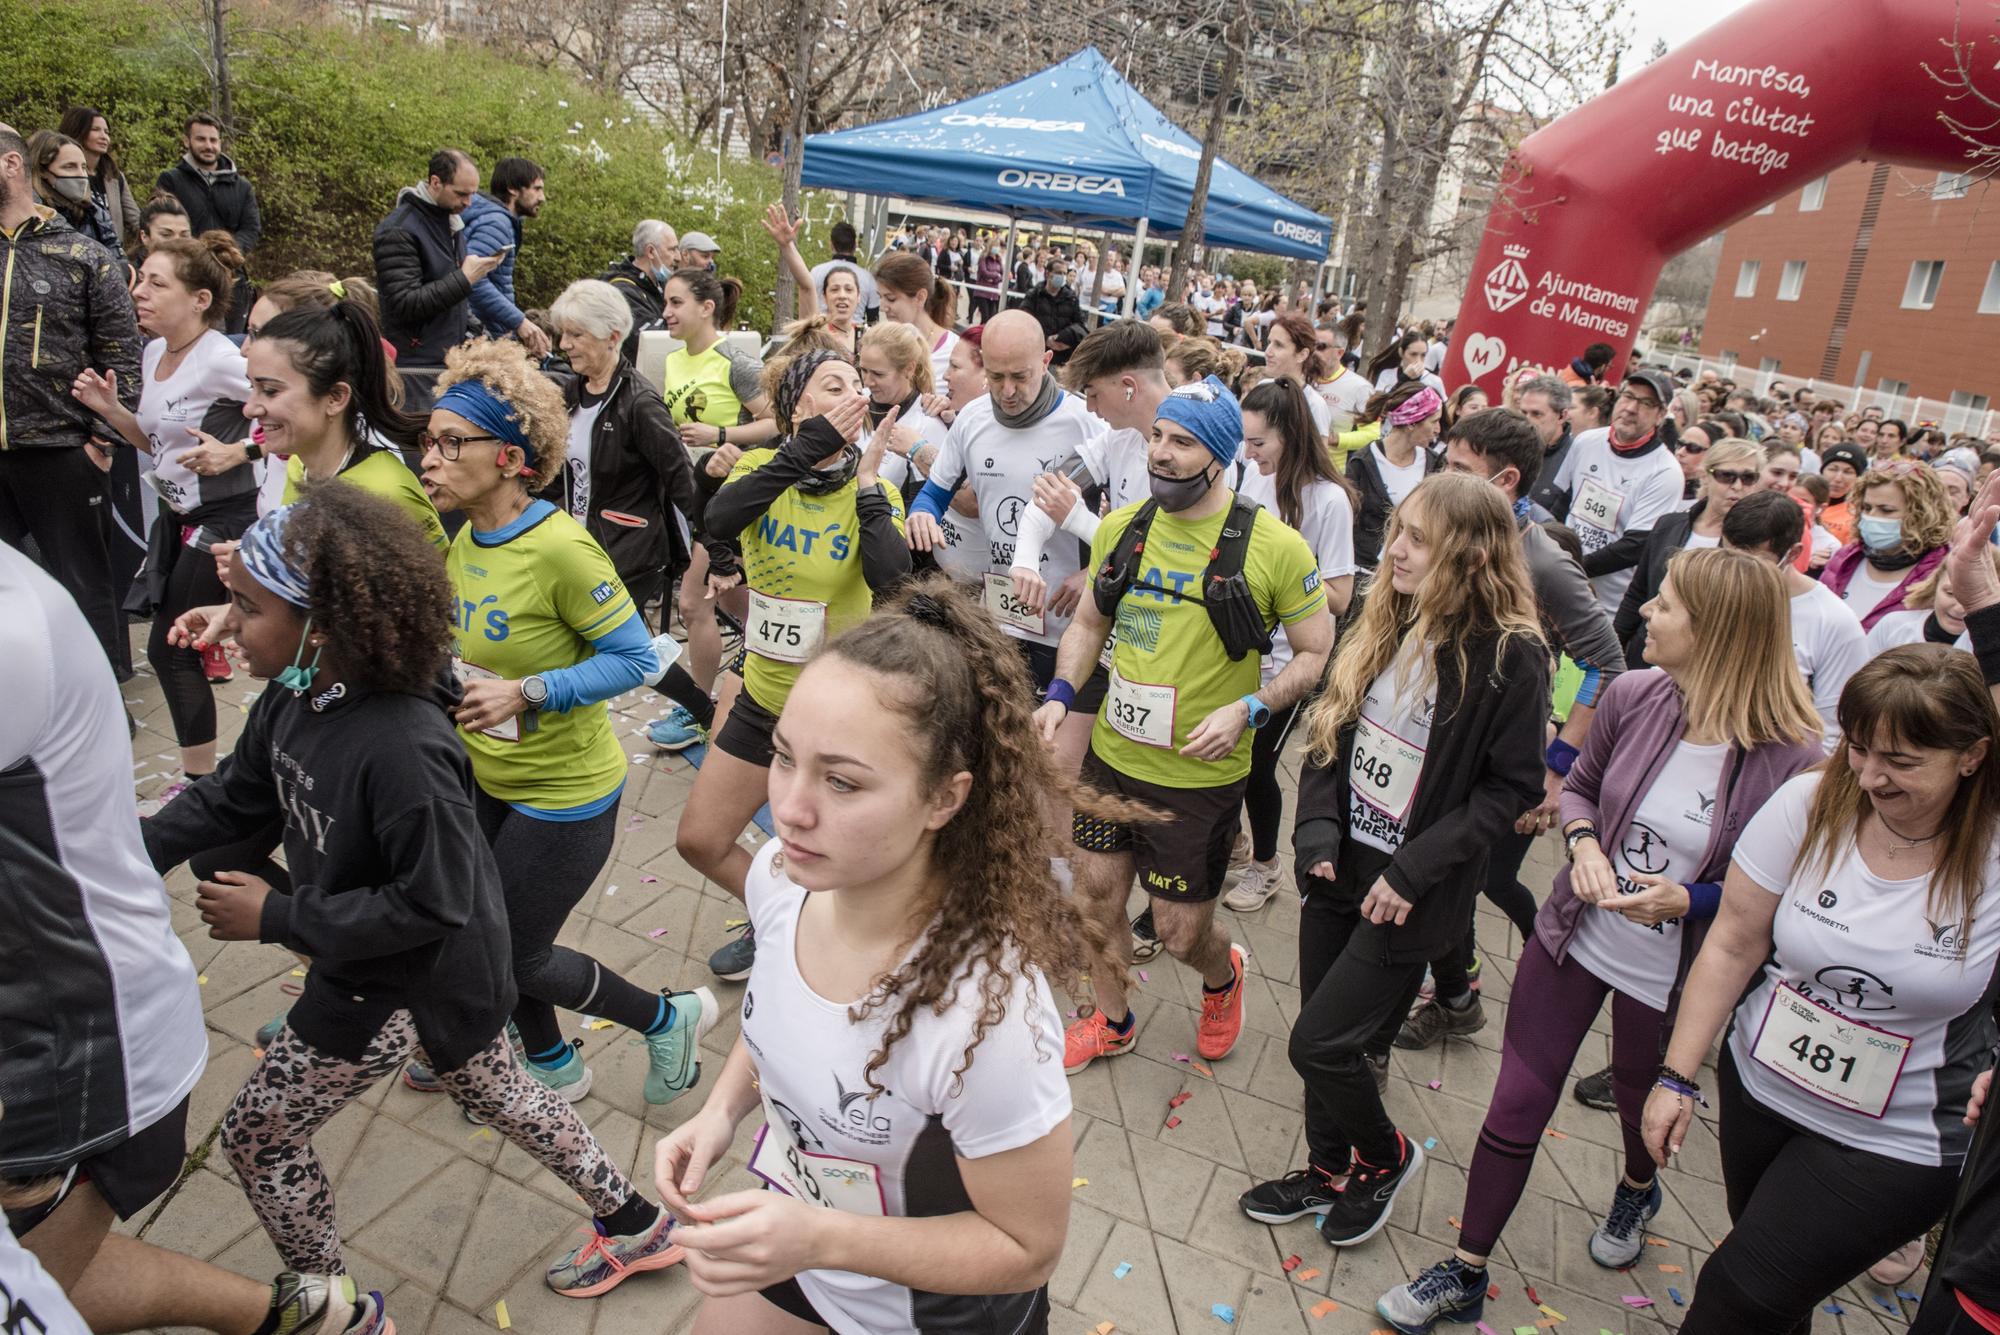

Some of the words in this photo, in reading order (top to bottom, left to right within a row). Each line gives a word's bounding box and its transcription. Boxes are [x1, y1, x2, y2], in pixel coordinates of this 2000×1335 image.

[1691, 59, 1810, 99] Manresa,
[941, 113, 1086, 133] ORBEA
[1668, 93, 1715, 118] una
[1725, 96, 1815, 137] ciutat
[1655, 127, 1702, 155] que
[1711, 130, 1790, 175] batega
[997, 169, 1126, 198] ORBEA
[1273, 219, 1322, 247] ORBEA
[1536, 271, 1639, 314] Ajuntament
[1529, 297, 1555, 318] de
[1559, 302, 1629, 338] Manresa
[1472, 348, 1490, 366] M
[1584, 498, 1606, 518] 548
[760, 620, 801, 646] 475
[1114, 697, 1151, 727] 337
[1116, 719, 1146, 735] ALBERTO
[1354, 746, 1392, 788] 648
[1350, 815, 1401, 847] NRESA
[1800, 905, 1850, 933] SAMARRETTA
[1789, 1034, 1857, 1083] 481
[1866, 1037, 1901, 1053] soom
[822, 1167, 870, 1182] soom
